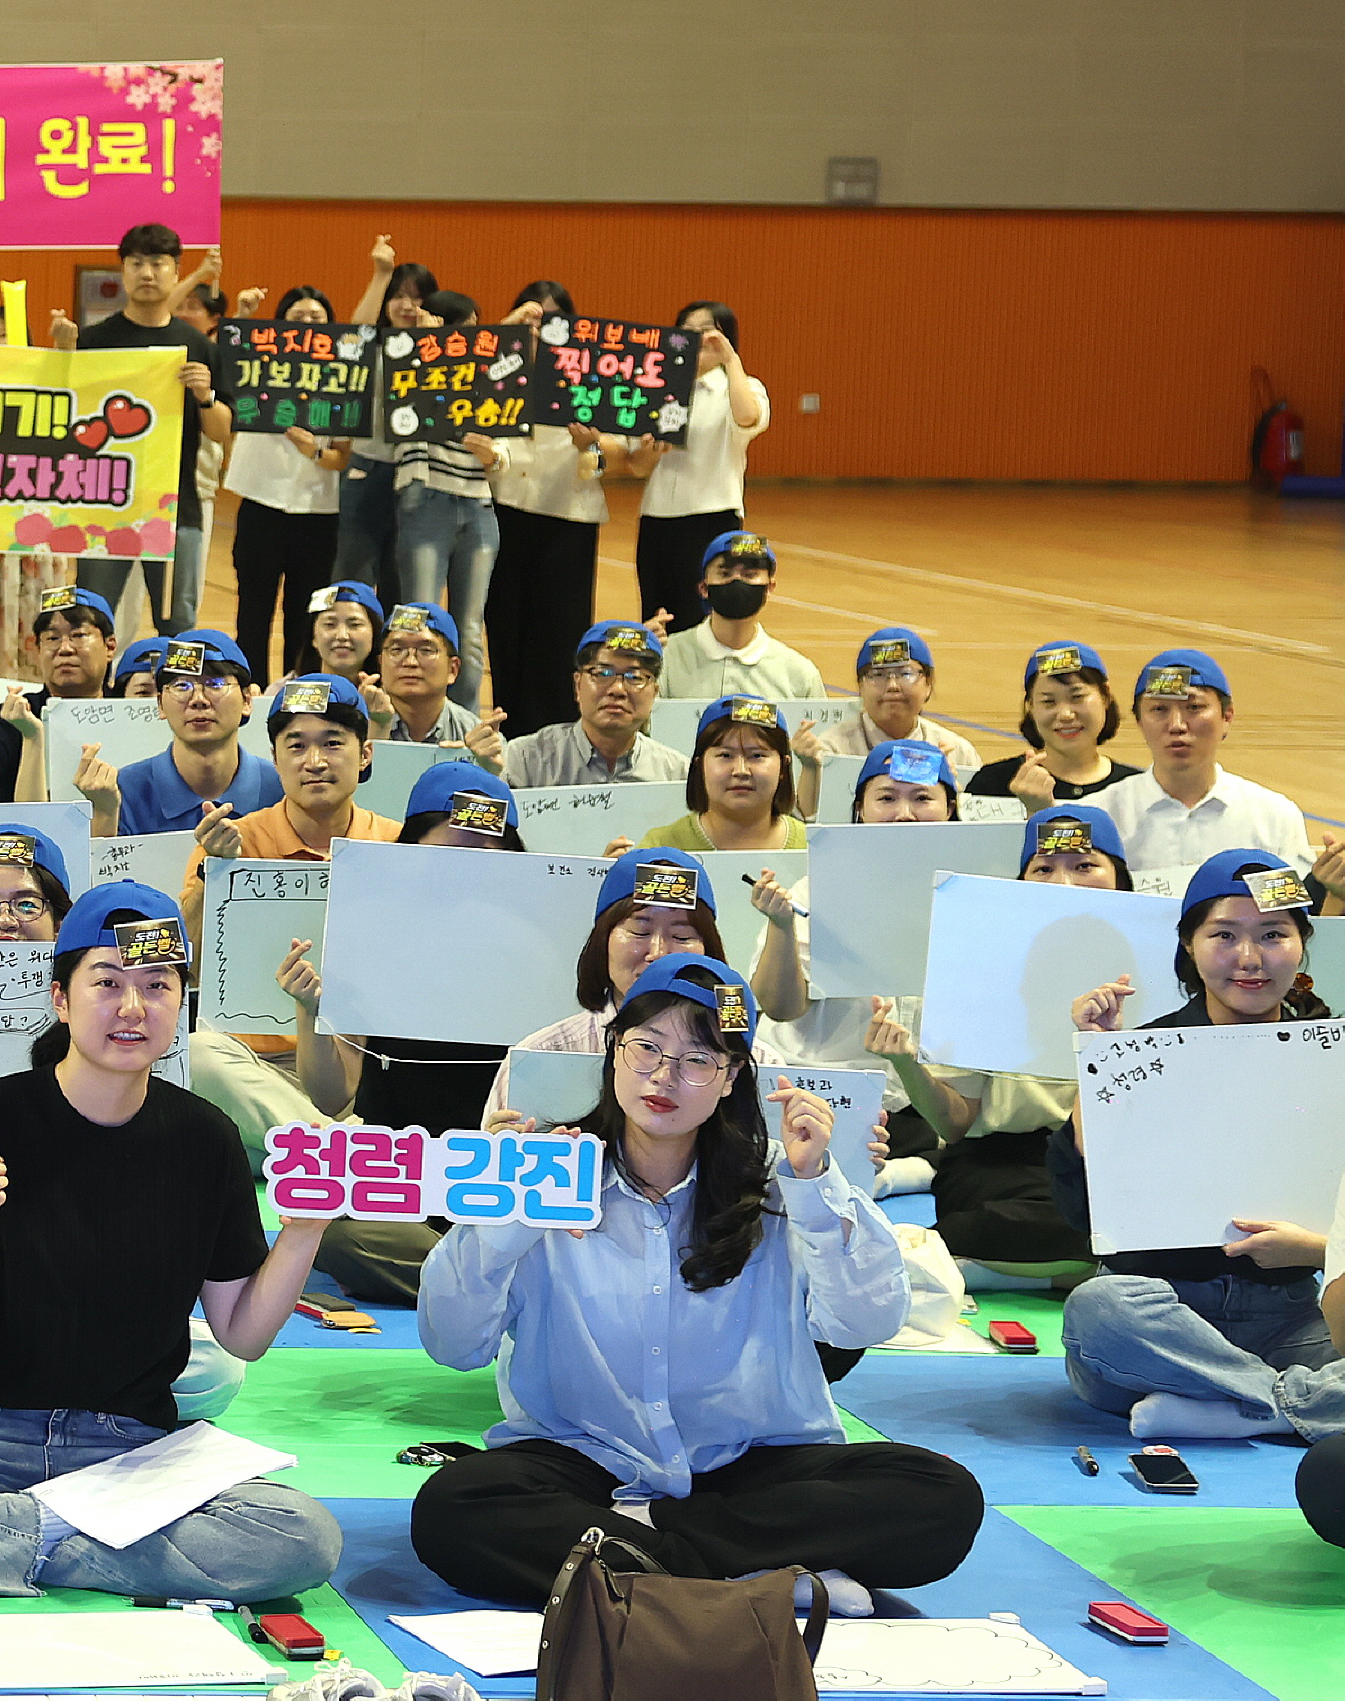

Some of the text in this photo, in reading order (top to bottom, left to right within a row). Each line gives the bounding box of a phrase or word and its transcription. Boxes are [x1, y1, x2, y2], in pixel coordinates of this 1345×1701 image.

[35, 116, 176, 198] 완료!
[391, 362, 476, 398] 무조건
[568, 386, 648, 428] 정답
[271, 1127, 596, 1221] 청렴 강진
